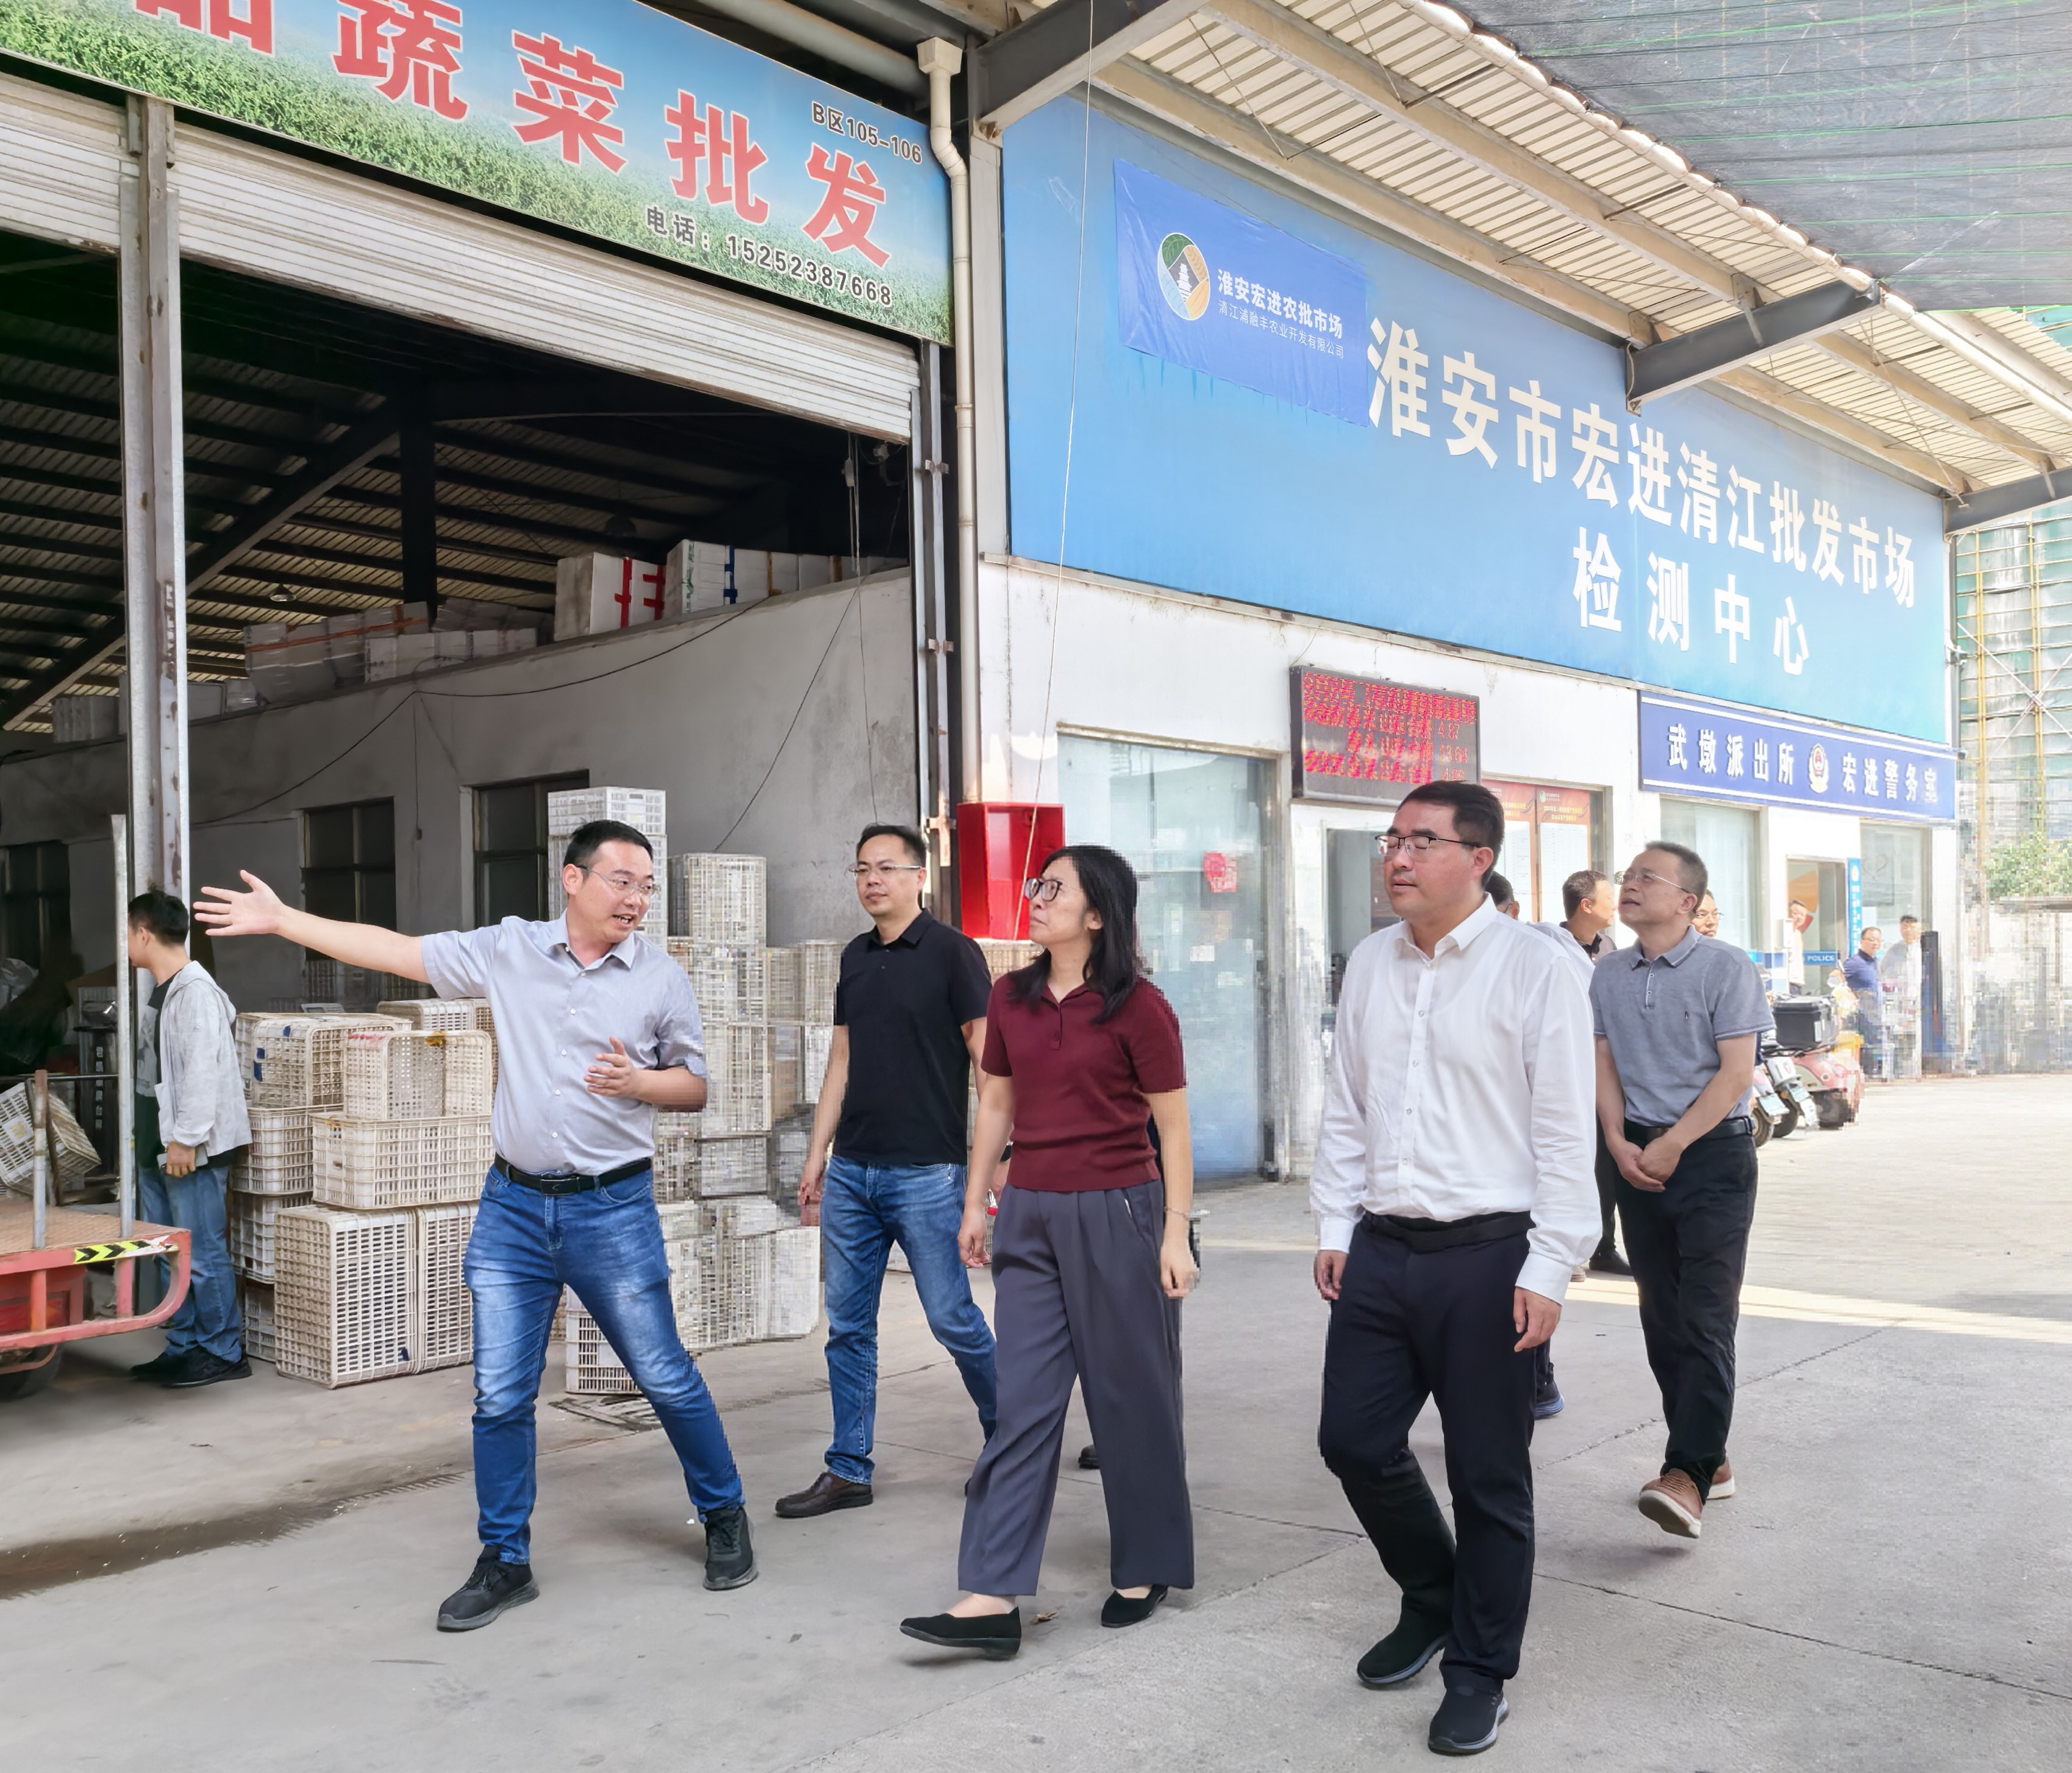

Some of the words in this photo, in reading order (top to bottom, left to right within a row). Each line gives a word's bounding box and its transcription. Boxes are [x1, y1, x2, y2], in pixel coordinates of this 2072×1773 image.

[811, 101, 923, 165] B区105-106
[1218, 269, 1342, 339] 淮安宏进农批市场
[1368, 317, 1915, 608] 淮安市宏进清江批发市场
[1572, 527, 1811, 676] 检测中心
[1667, 722, 1795, 785] 武墩派出所
